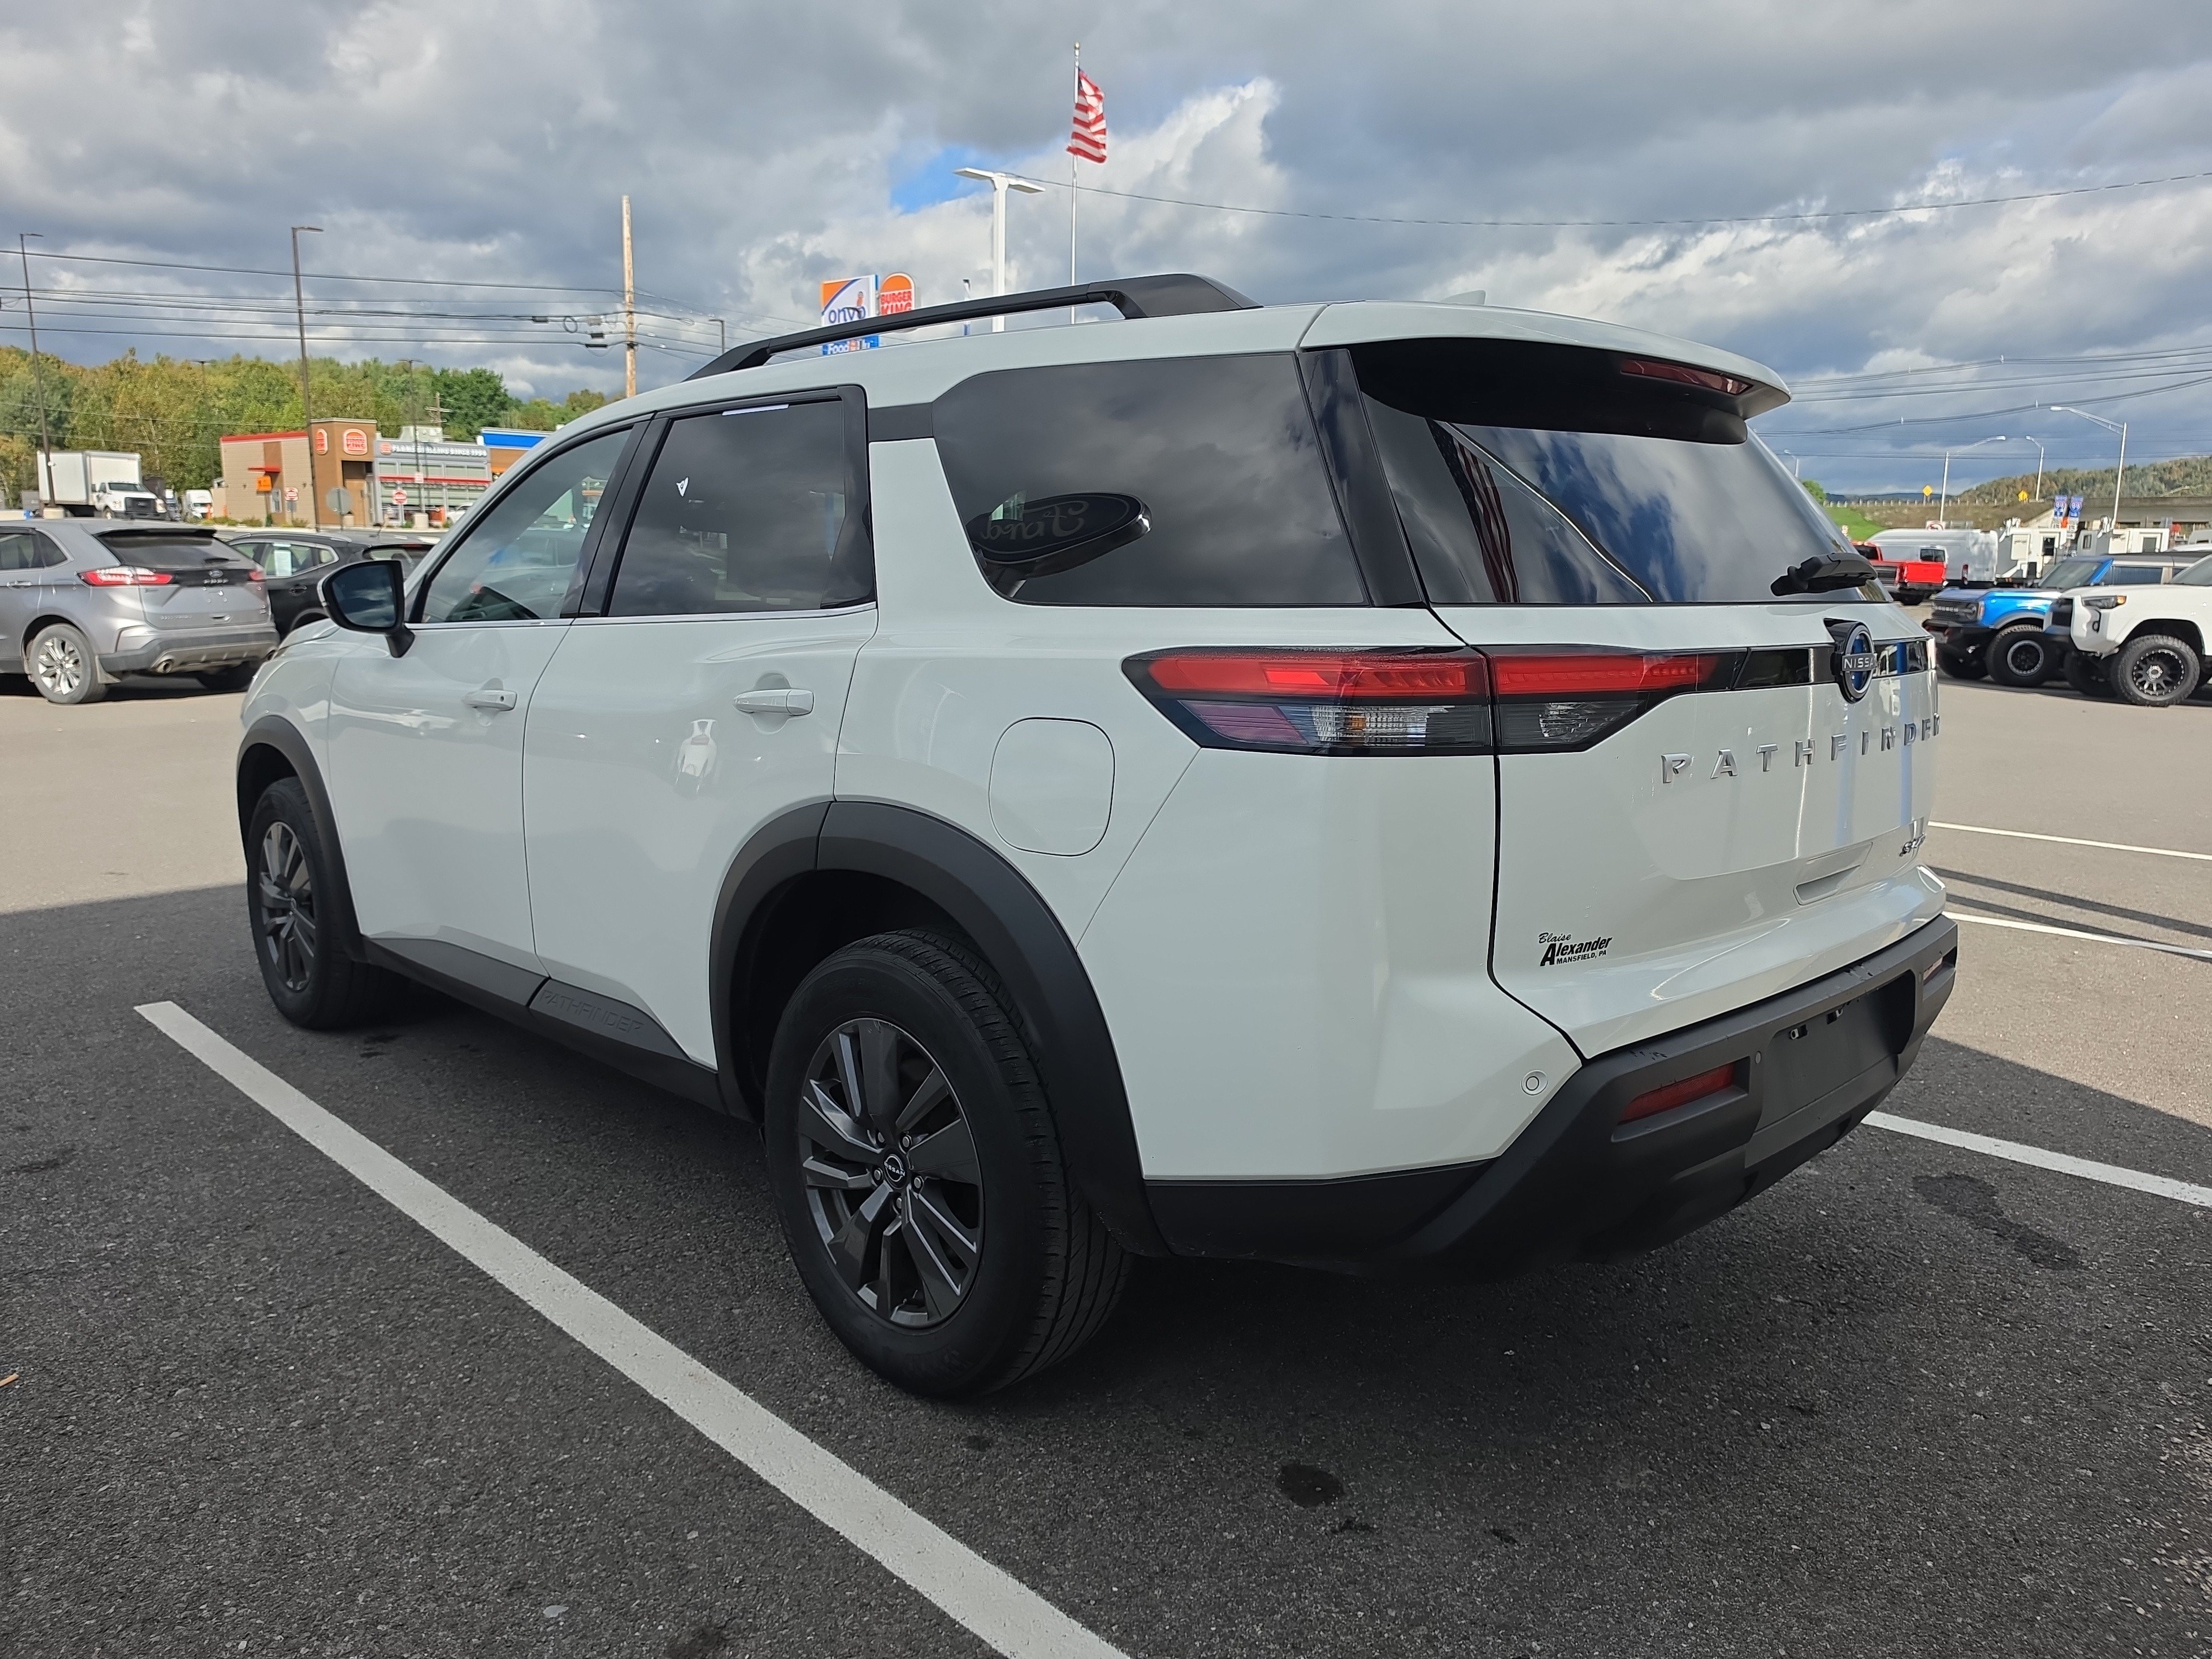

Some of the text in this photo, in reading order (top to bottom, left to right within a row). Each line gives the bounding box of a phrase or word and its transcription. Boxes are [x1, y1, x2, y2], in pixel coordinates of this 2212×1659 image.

[881, 291, 912, 304] BURGER
[881, 302, 912, 316] KING
[1844, 657, 1874, 669] NISSA
[1661, 712, 1940, 783] PATHFINDER
[1538, 932, 1572, 944] Blaise
[1540, 936, 1613, 967] Alexander
[1556, 952, 1597, 965] MANSFIELD,
[884, 1161, 905, 1176] NISSAN
